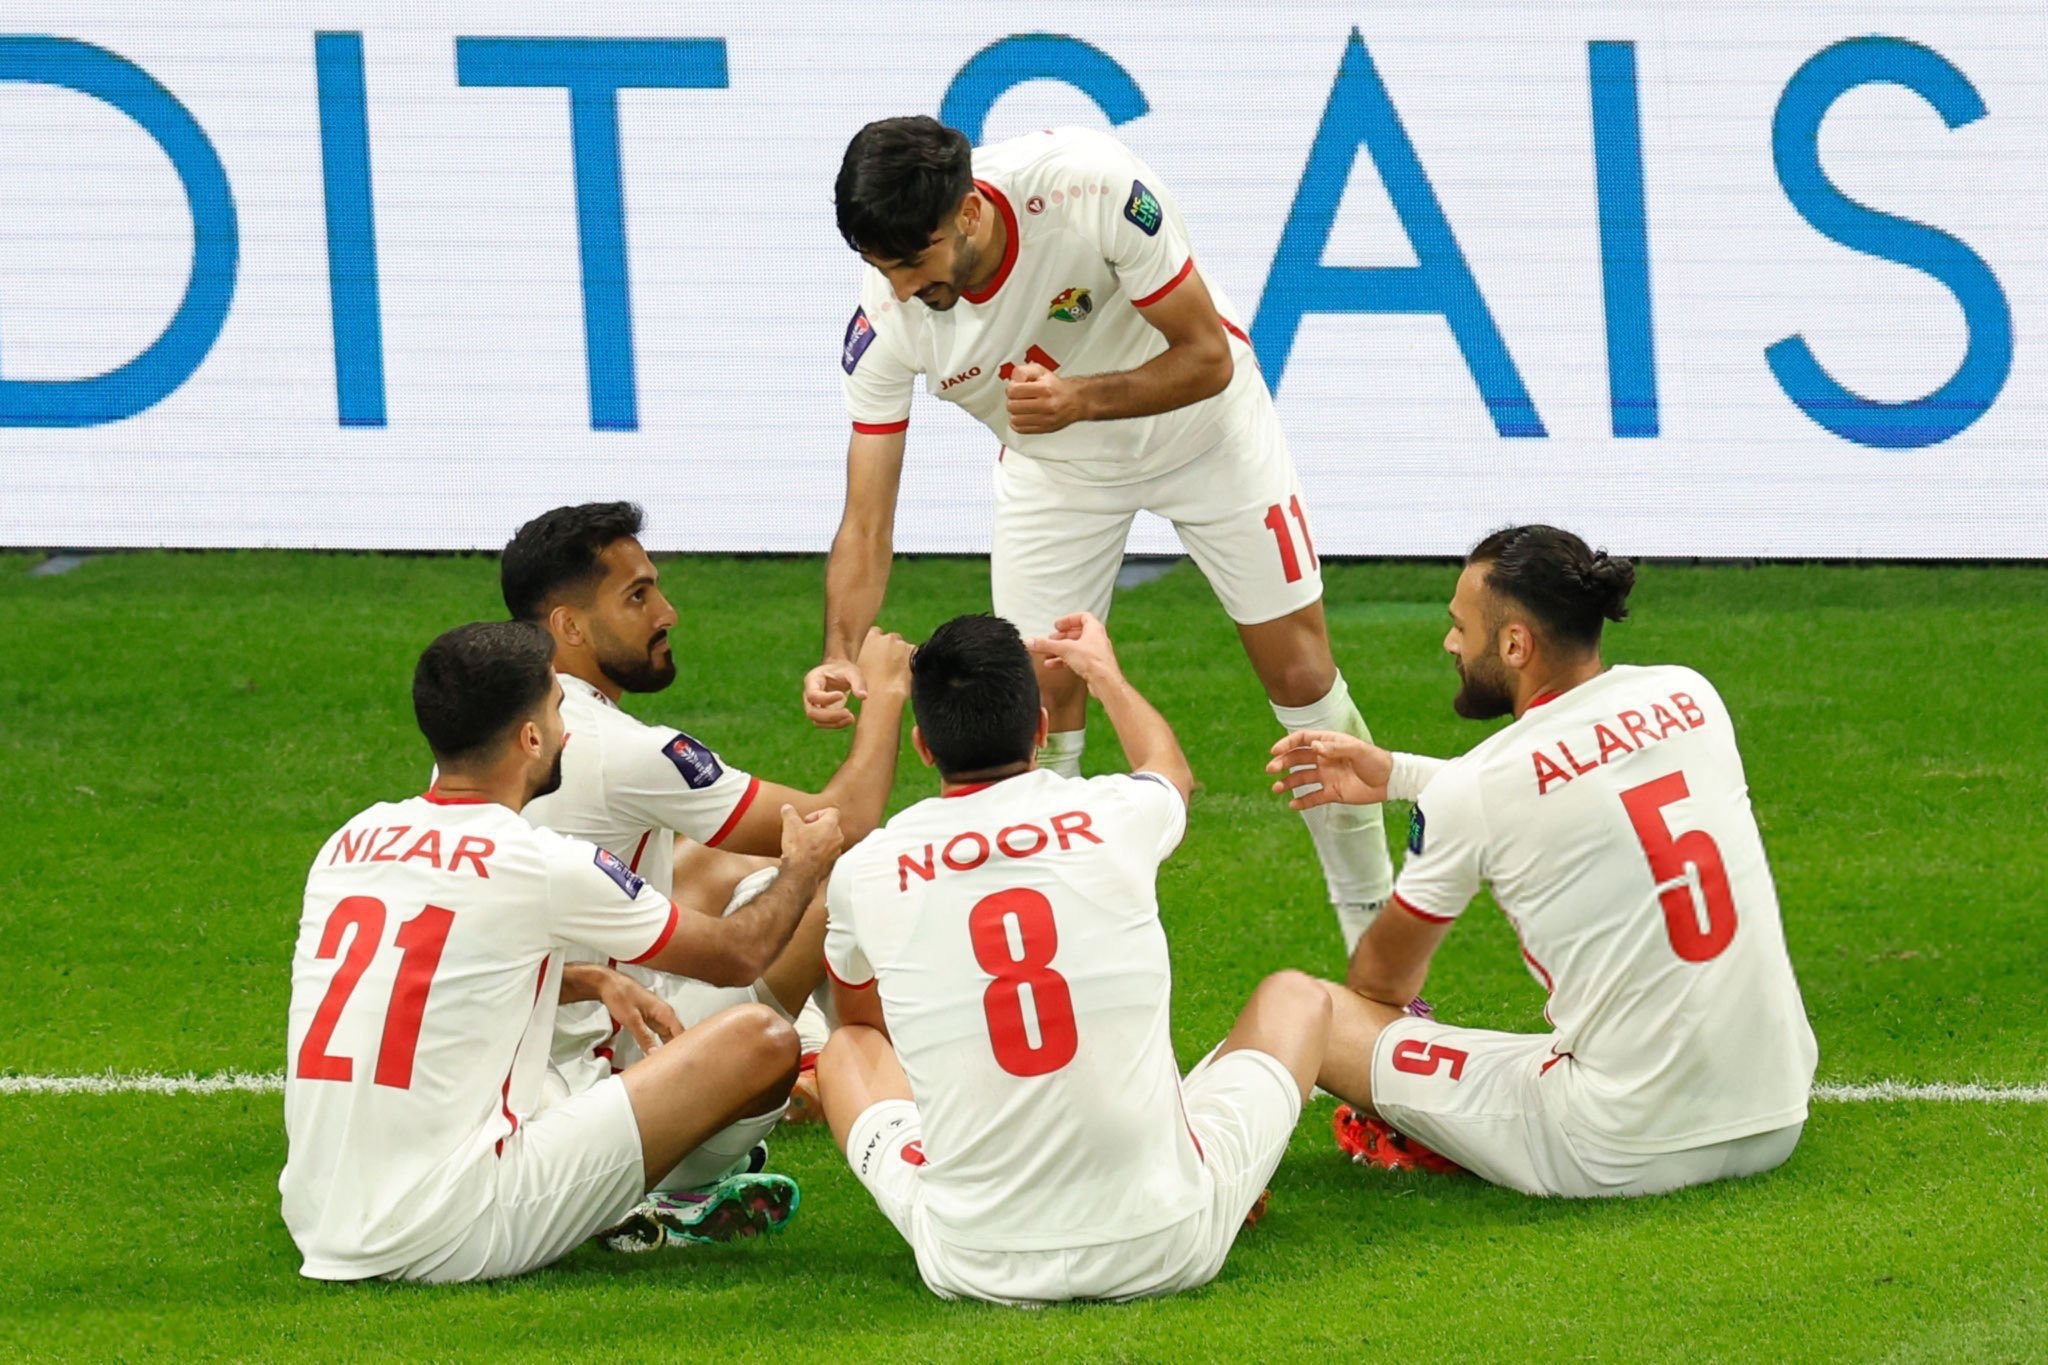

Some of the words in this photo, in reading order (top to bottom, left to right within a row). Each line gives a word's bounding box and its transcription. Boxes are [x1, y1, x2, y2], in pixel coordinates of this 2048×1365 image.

[940, 366, 982, 391] JAKO
[1532, 692, 1706, 796] ALARAB
[328, 825, 496, 880] NIZAR
[897, 810, 1105, 892] NOOR
[1619, 769, 1738, 964] 5
[296, 895, 456, 1090] 21
[968, 887, 1079, 1078] 8
[1392, 1039, 1470, 1082] 5
